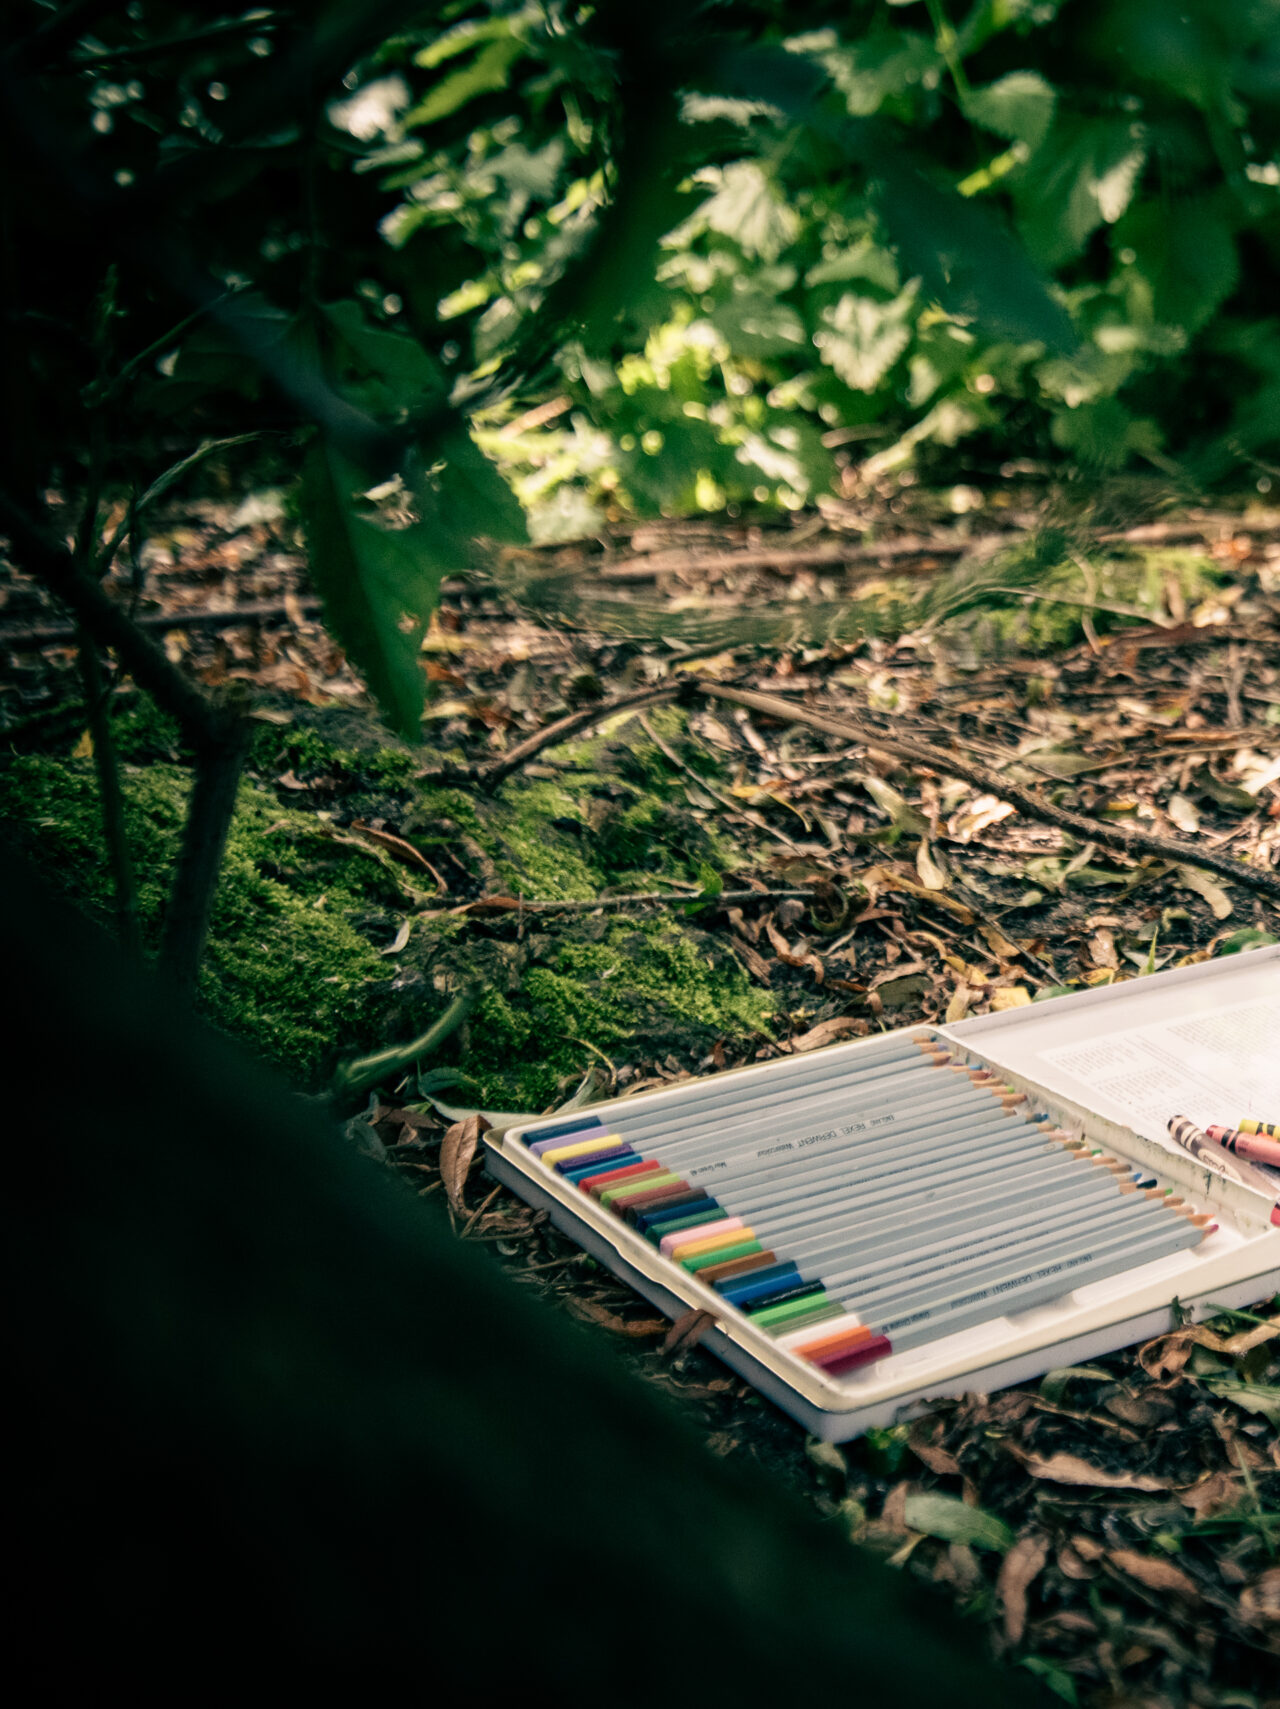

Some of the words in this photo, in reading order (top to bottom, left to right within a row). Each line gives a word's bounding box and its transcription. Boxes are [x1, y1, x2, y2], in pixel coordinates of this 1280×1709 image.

[840, 1123, 866, 1135] REXEL
[798, 1130, 837, 1147] DERWENT
[993, 1275, 1032, 1294] DERWENT
